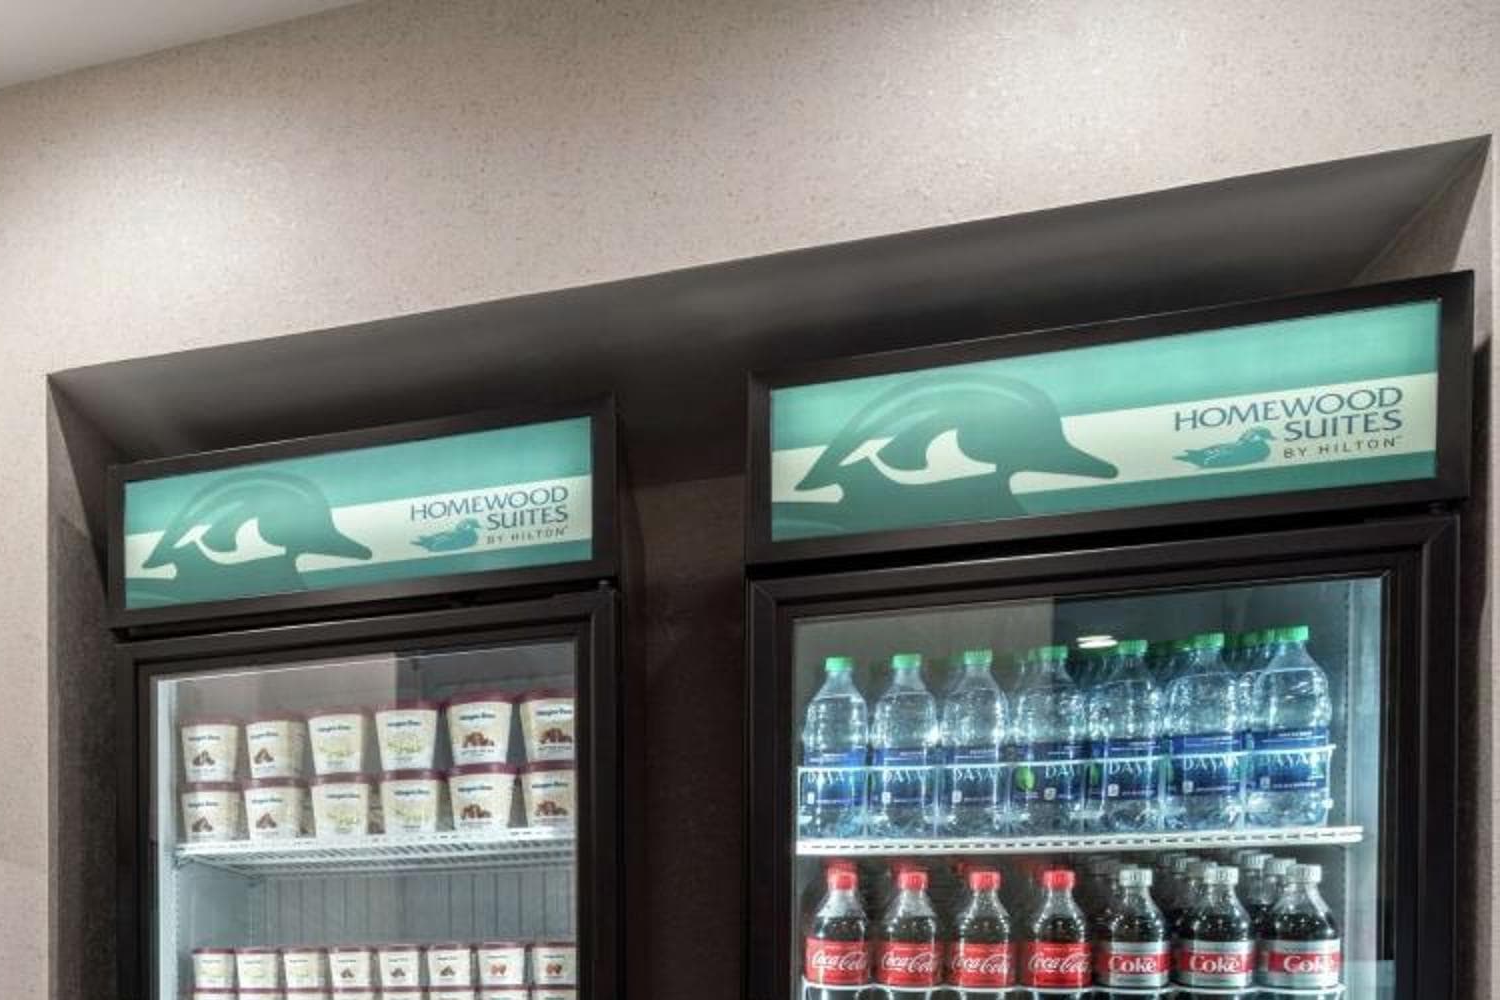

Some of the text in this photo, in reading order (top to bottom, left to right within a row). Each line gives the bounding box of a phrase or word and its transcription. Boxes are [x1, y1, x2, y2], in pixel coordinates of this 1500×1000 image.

[1174, 386, 1404, 432] HOMEWOOD
[1283, 409, 1403, 443] SUITES
[1283, 437, 1397, 459] BY HILTON
[410, 485, 569, 522] HOMEWOOD
[486, 505, 569, 531] SUITES
[486, 526, 566, 545] BY HILTON
[1108, 955, 1157, 973] Coke
[1190, 954, 1239, 973] Coke
